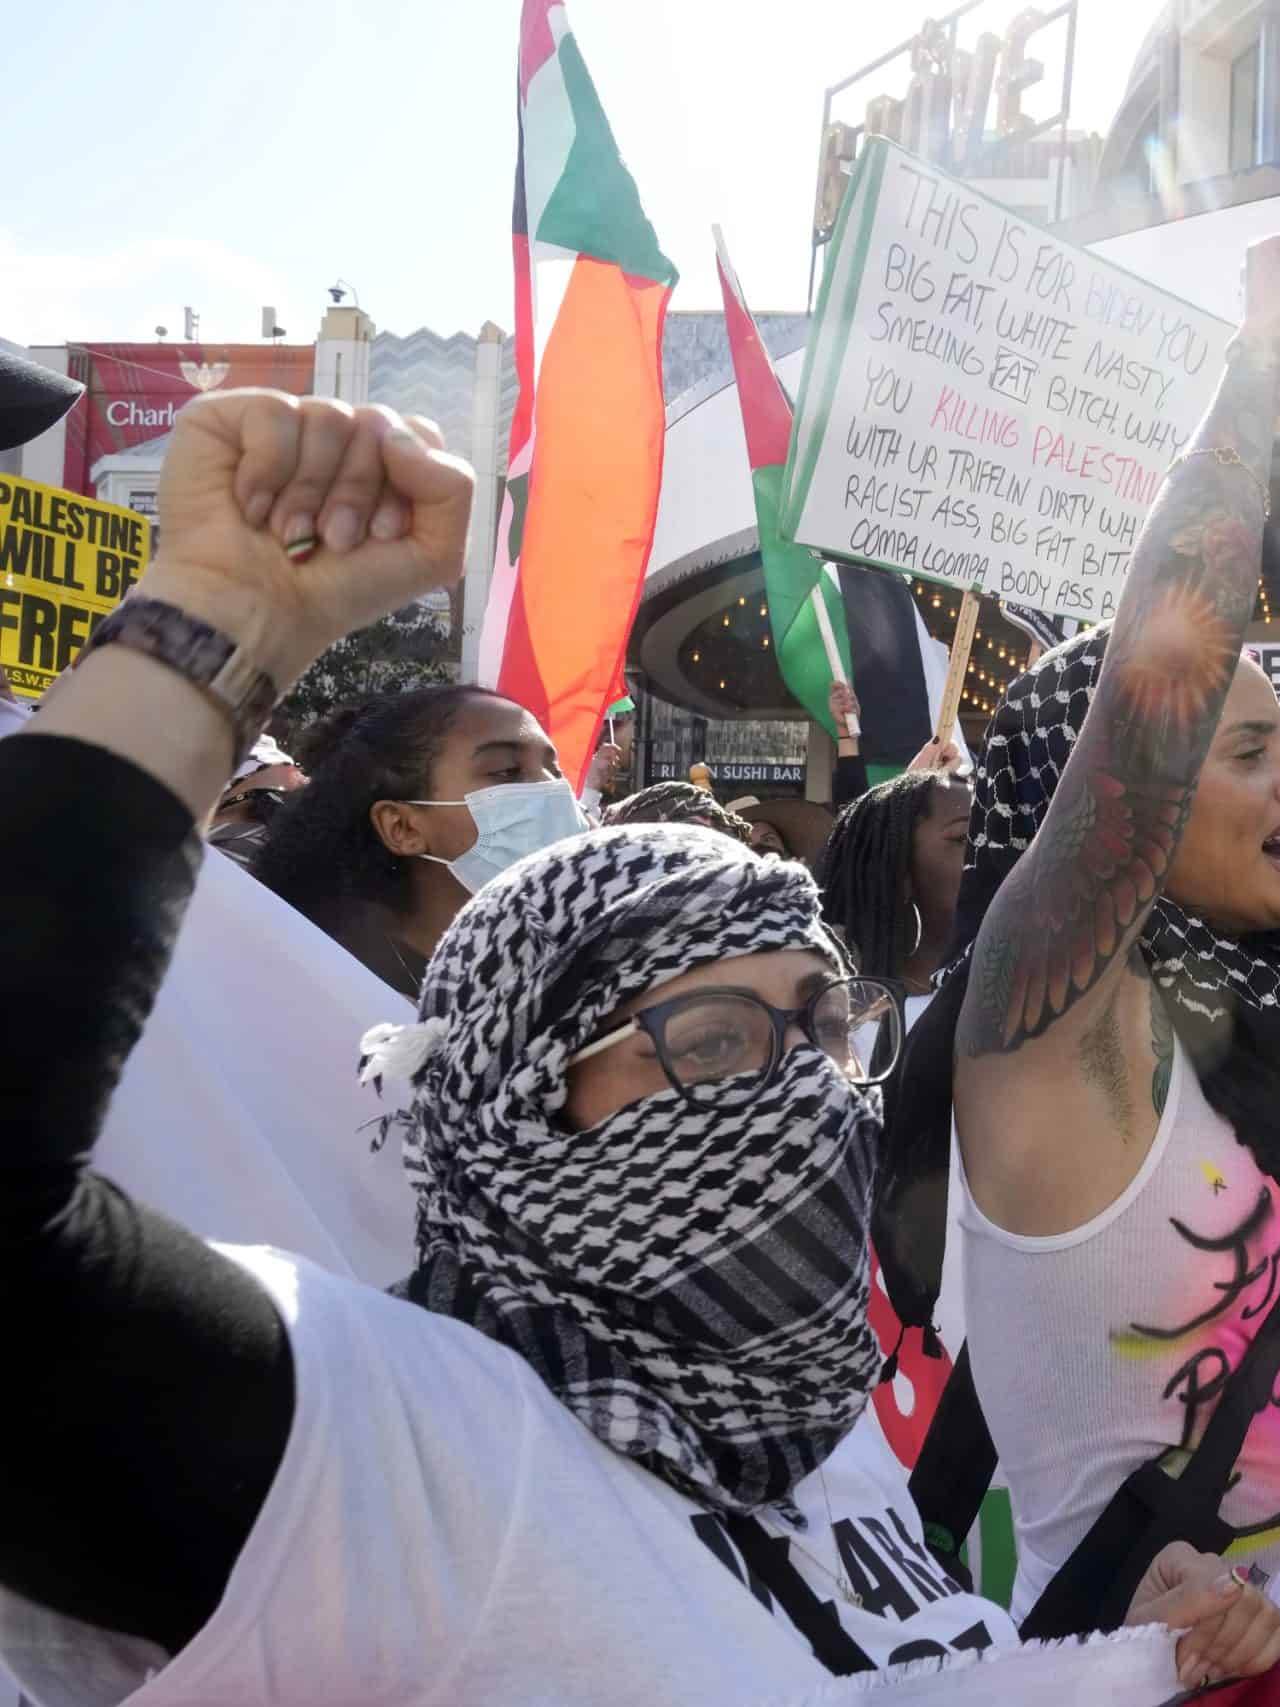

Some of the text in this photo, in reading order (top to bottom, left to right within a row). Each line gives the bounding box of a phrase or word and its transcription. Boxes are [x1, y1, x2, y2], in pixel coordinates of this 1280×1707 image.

[884, 243, 935, 302] BIG
[996, 298, 1078, 360] WHITE
[900, 164, 979, 264] THIS
[988, 218, 1027, 282] IS
[1026, 245, 1074, 312] FOR
[1156, 311, 1209, 375] YOU
[864, 356, 1162, 506] YOU KILLING PALESTINI
[869, 301, 984, 375] SMELLING
[990, 353, 1036, 396] FAT
[1124, 413, 1190, 464] WHY
[845, 474, 933, 521] RACIST
[990, 511, 1028, 545] BIG
[1035, 525, 1077, 567] FAT
[846, 416, 902, 470] WITH
[908, 440, 938, 483] UR
[946, 450, 1030, 506] TRIFFLIN
[1038, 485, 1095, 528] DIRTY
[0, 524, 84, 591] WILL
[850, 518, 919, 569] OOMPA
[921, 543, 989, 583] LOOMPA
[1001, 561, 1051, 607] BODY
[1056, 580, 1094, 609] ASS
[723, 766, 767, 780] SUSHI
[773, 766, 801, 781] BAR
